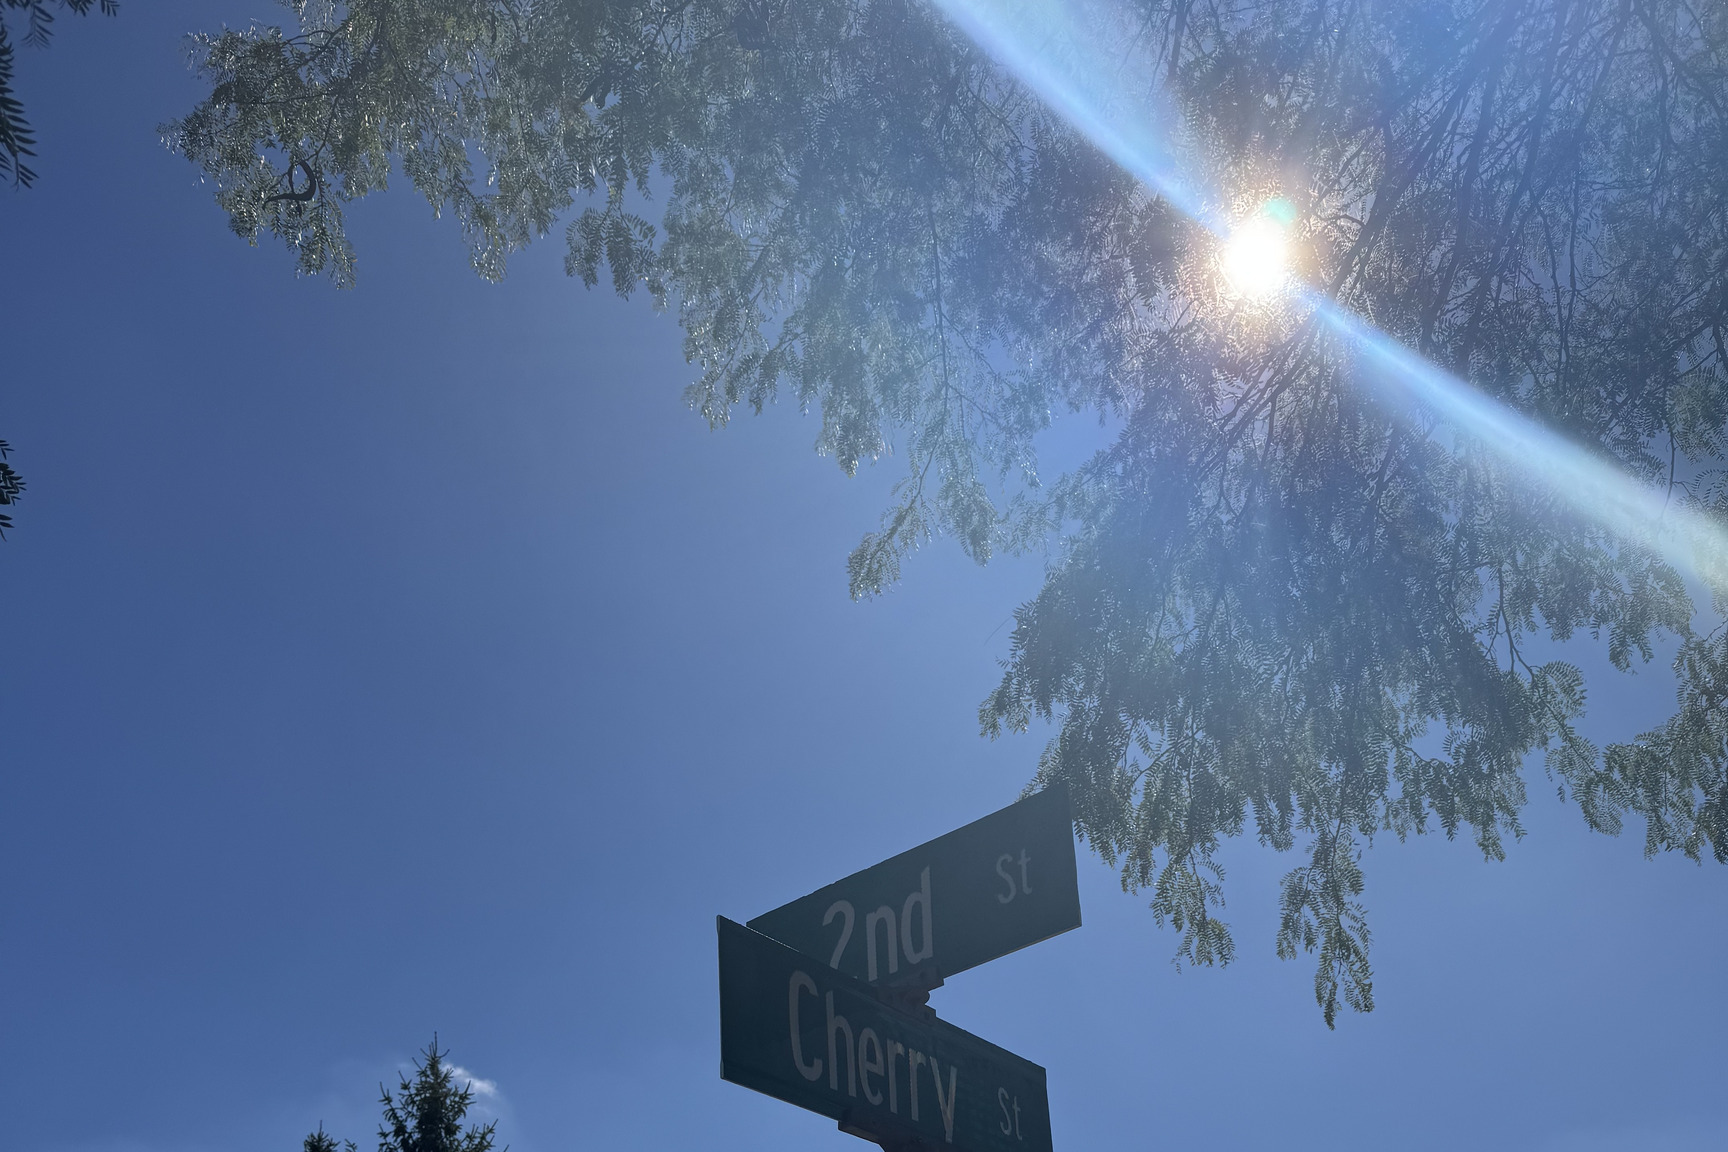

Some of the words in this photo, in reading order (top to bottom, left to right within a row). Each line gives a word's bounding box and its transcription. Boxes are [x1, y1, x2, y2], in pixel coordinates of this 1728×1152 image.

[822, 865, 933, 982] 2nd
[995, 849, 1033, 904] St
[788, 969, 958, 1145] Cherry
[997, 1087, 1023, 1141] St
